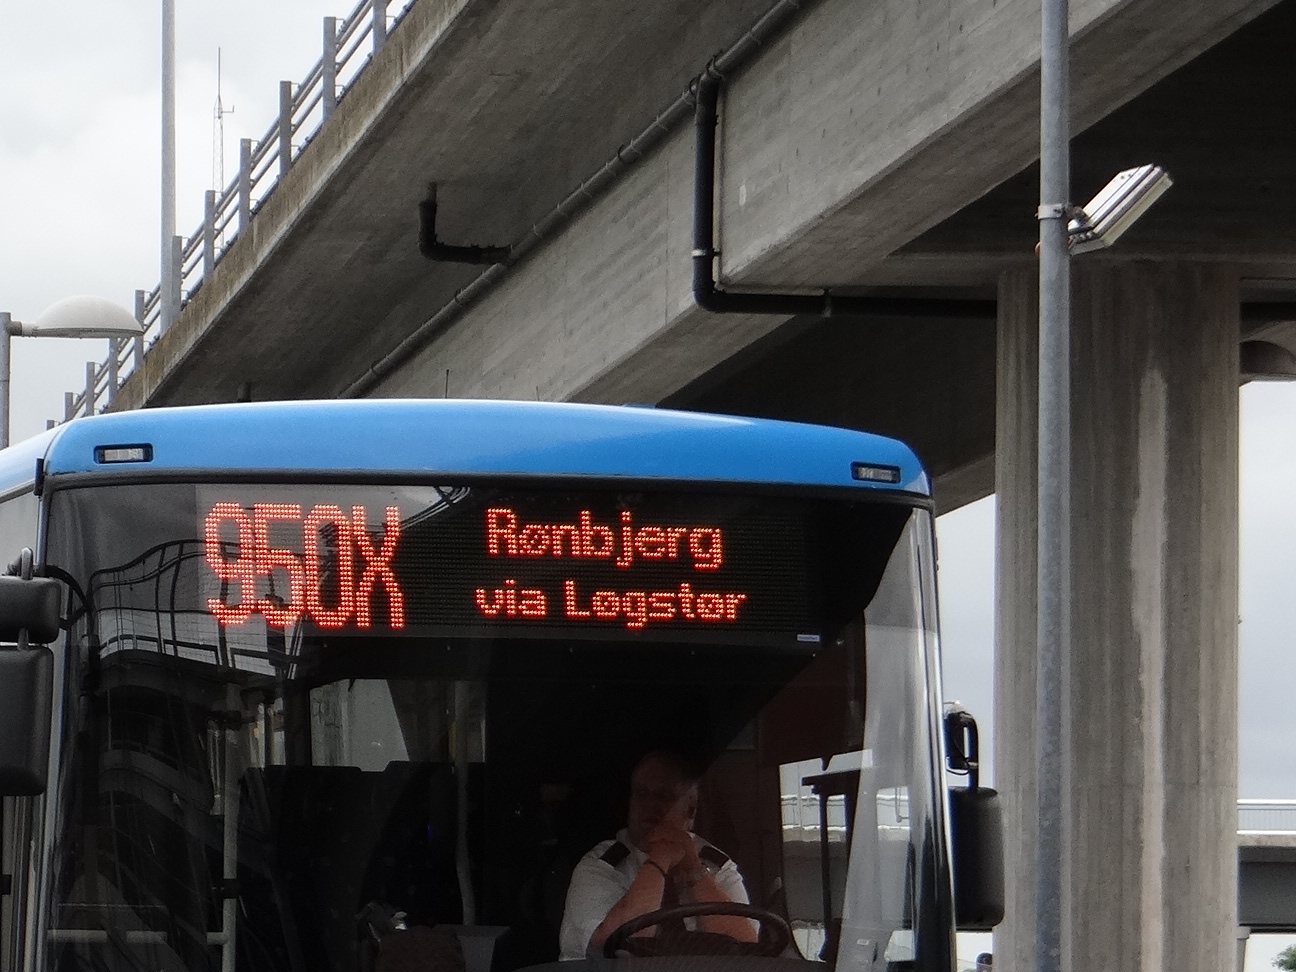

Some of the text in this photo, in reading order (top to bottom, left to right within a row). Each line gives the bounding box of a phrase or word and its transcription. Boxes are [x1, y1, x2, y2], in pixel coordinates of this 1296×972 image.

[204, 502, 406, 630] 950X
[486, 507, 724, 570] Rønbjerg
[474, 578, 748, 628] via Løgstør
